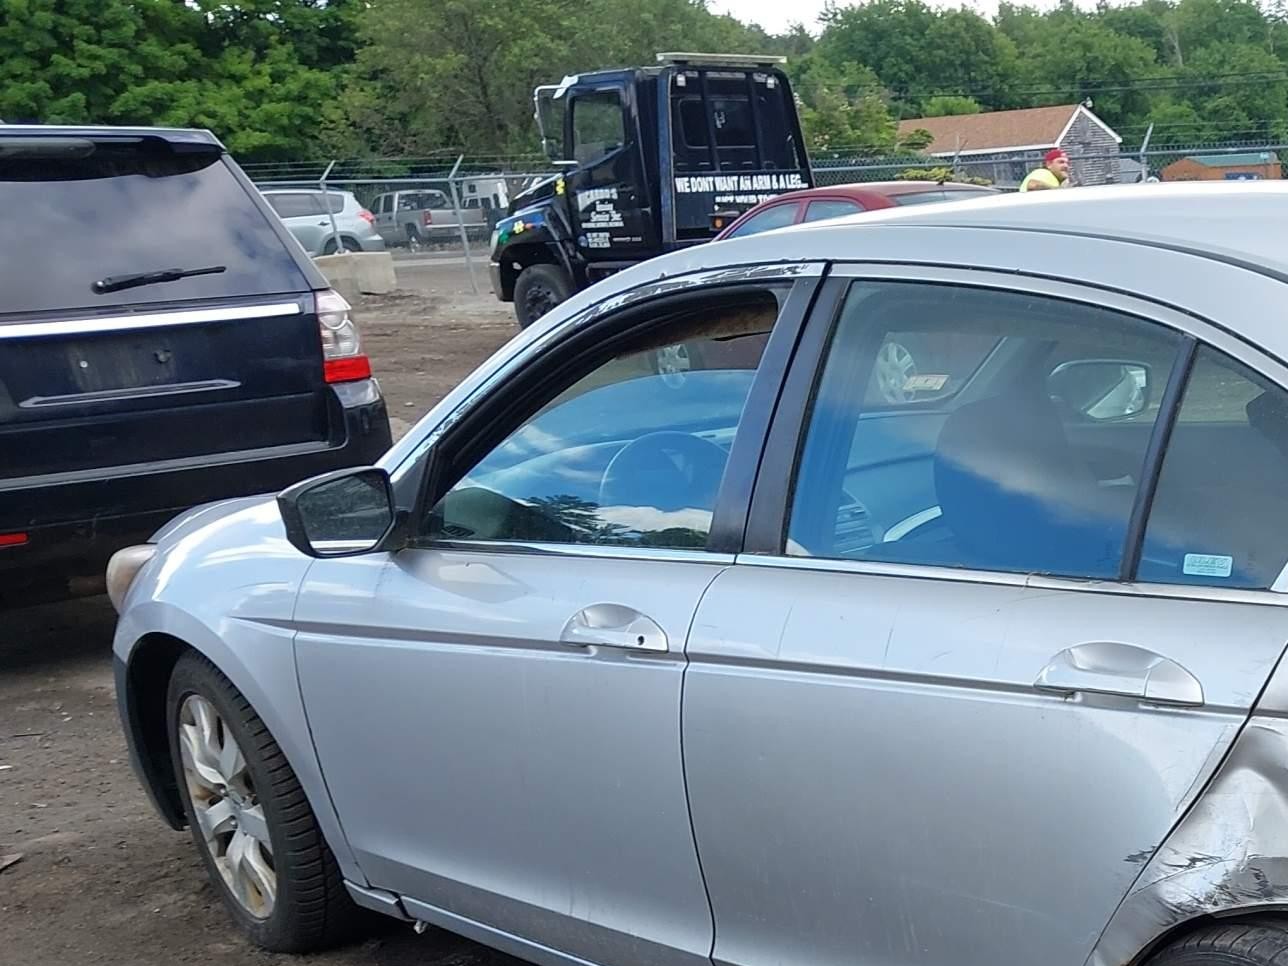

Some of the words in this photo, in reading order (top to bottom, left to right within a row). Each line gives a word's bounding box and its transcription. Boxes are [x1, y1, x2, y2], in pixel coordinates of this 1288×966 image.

[675, 177, 691, 193] WE
[690, 176, 714, 193] DONT
[715, 175, 739, 192] WANT
[752, 174, 771, 191] ARM
[779, 174, 786, 189] A
